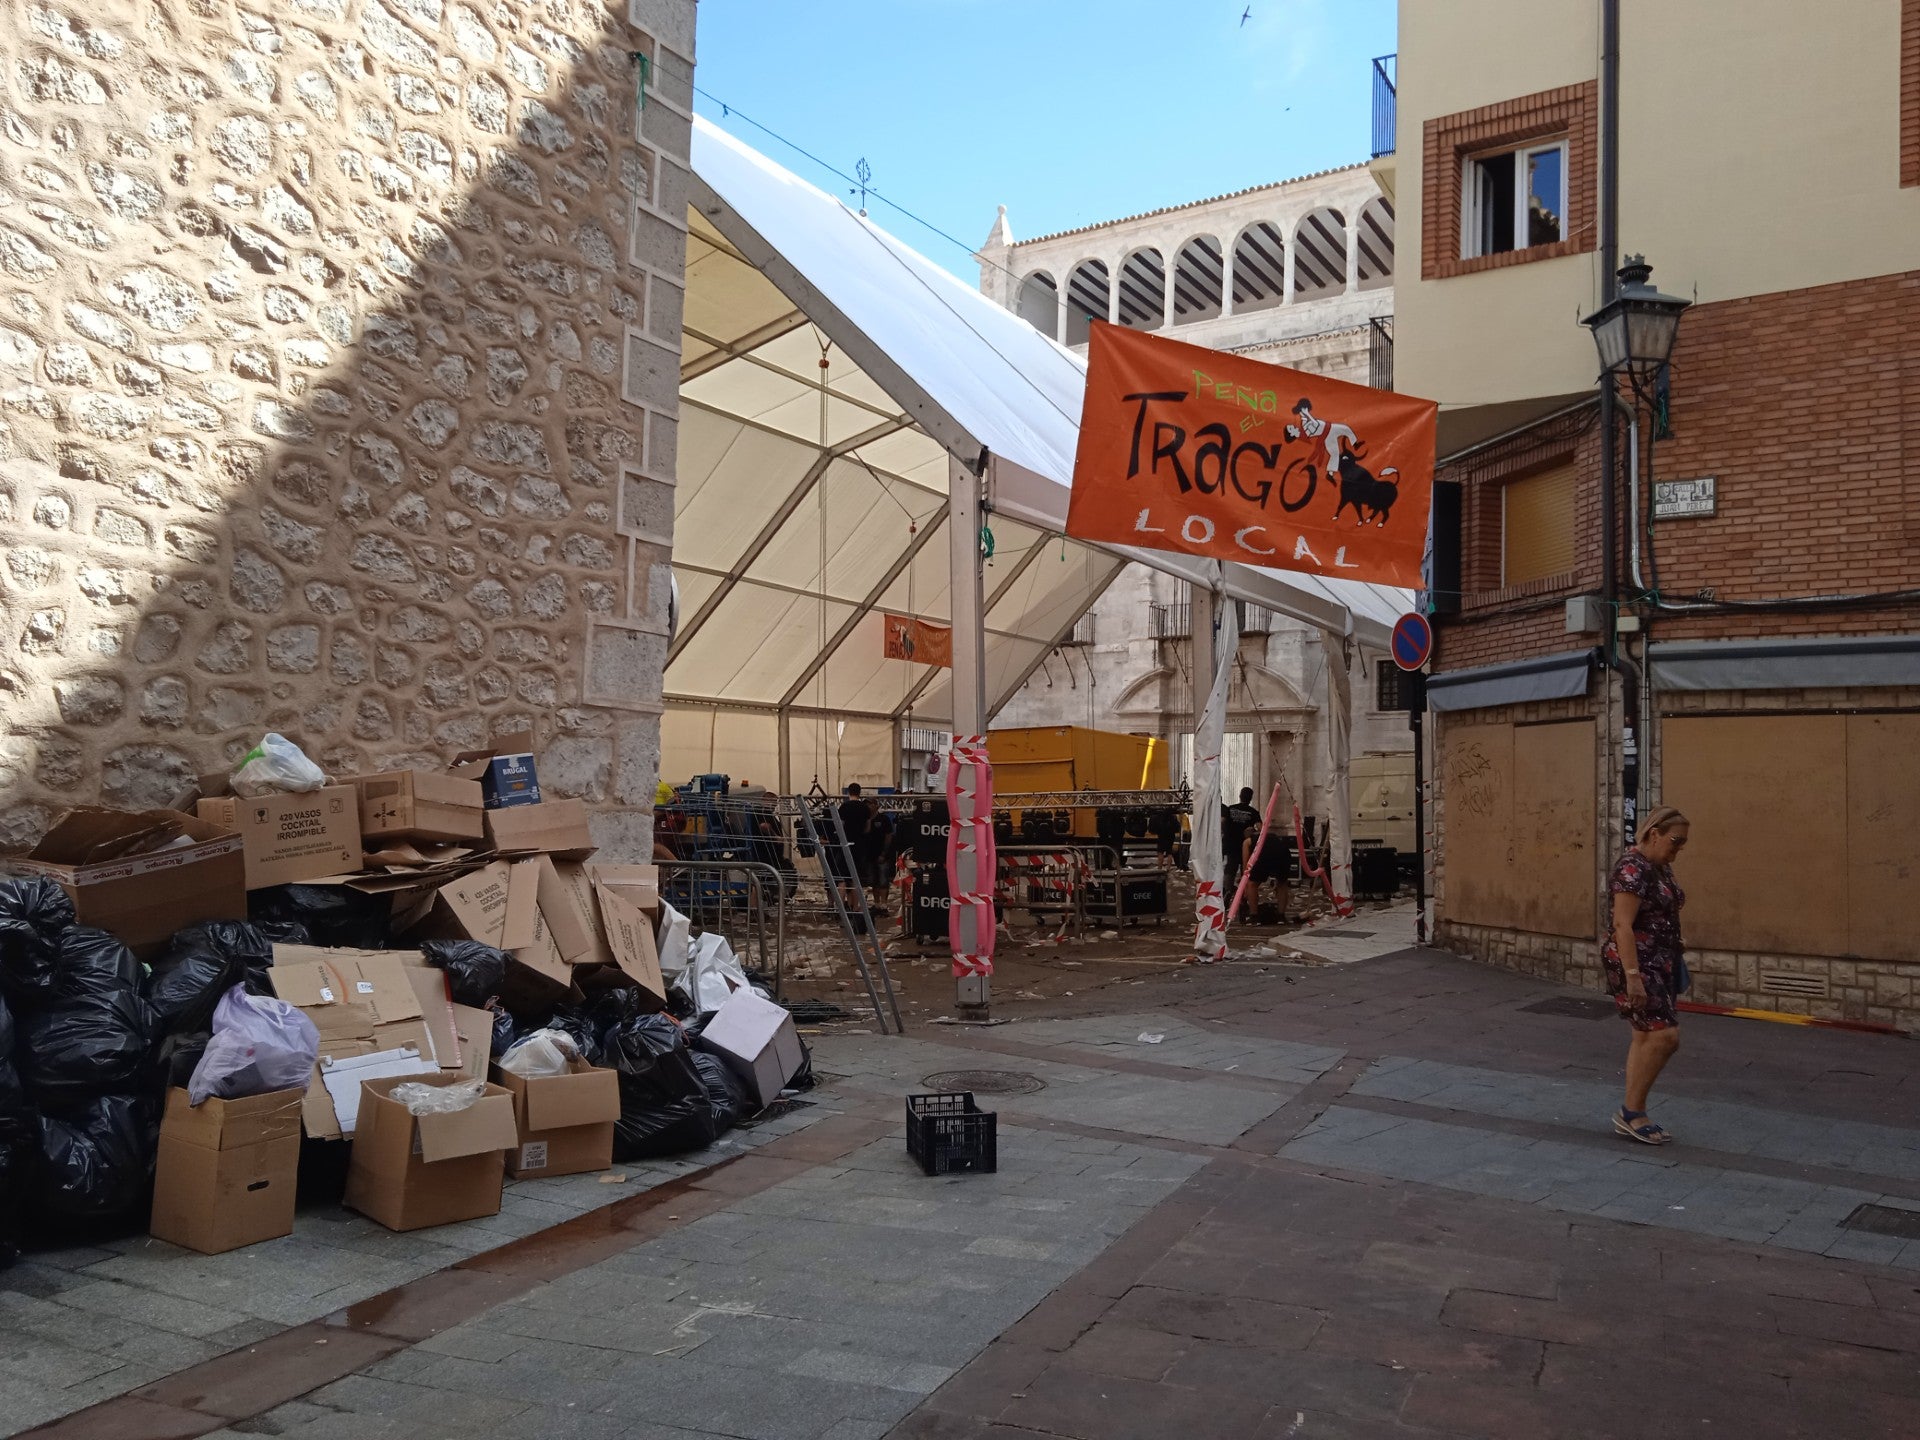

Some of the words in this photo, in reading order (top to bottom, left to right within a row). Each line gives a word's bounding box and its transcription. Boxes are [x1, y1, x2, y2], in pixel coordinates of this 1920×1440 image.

[1240, 412, 1265, 433] EL
[1134, 508, 1360, 568] LOCAL
[502, 766, 528, 776] BRUGAL
[279, 812, 293, 822] 420
[294, 809, 321, 819] VASOS
[281, 819, 321, 831] COCKTAIL
[921, 824, 950, 837] DAG
[277, 827, 326, 840] IRROMPIBLE
[921, 896, 950, 909] DAG
